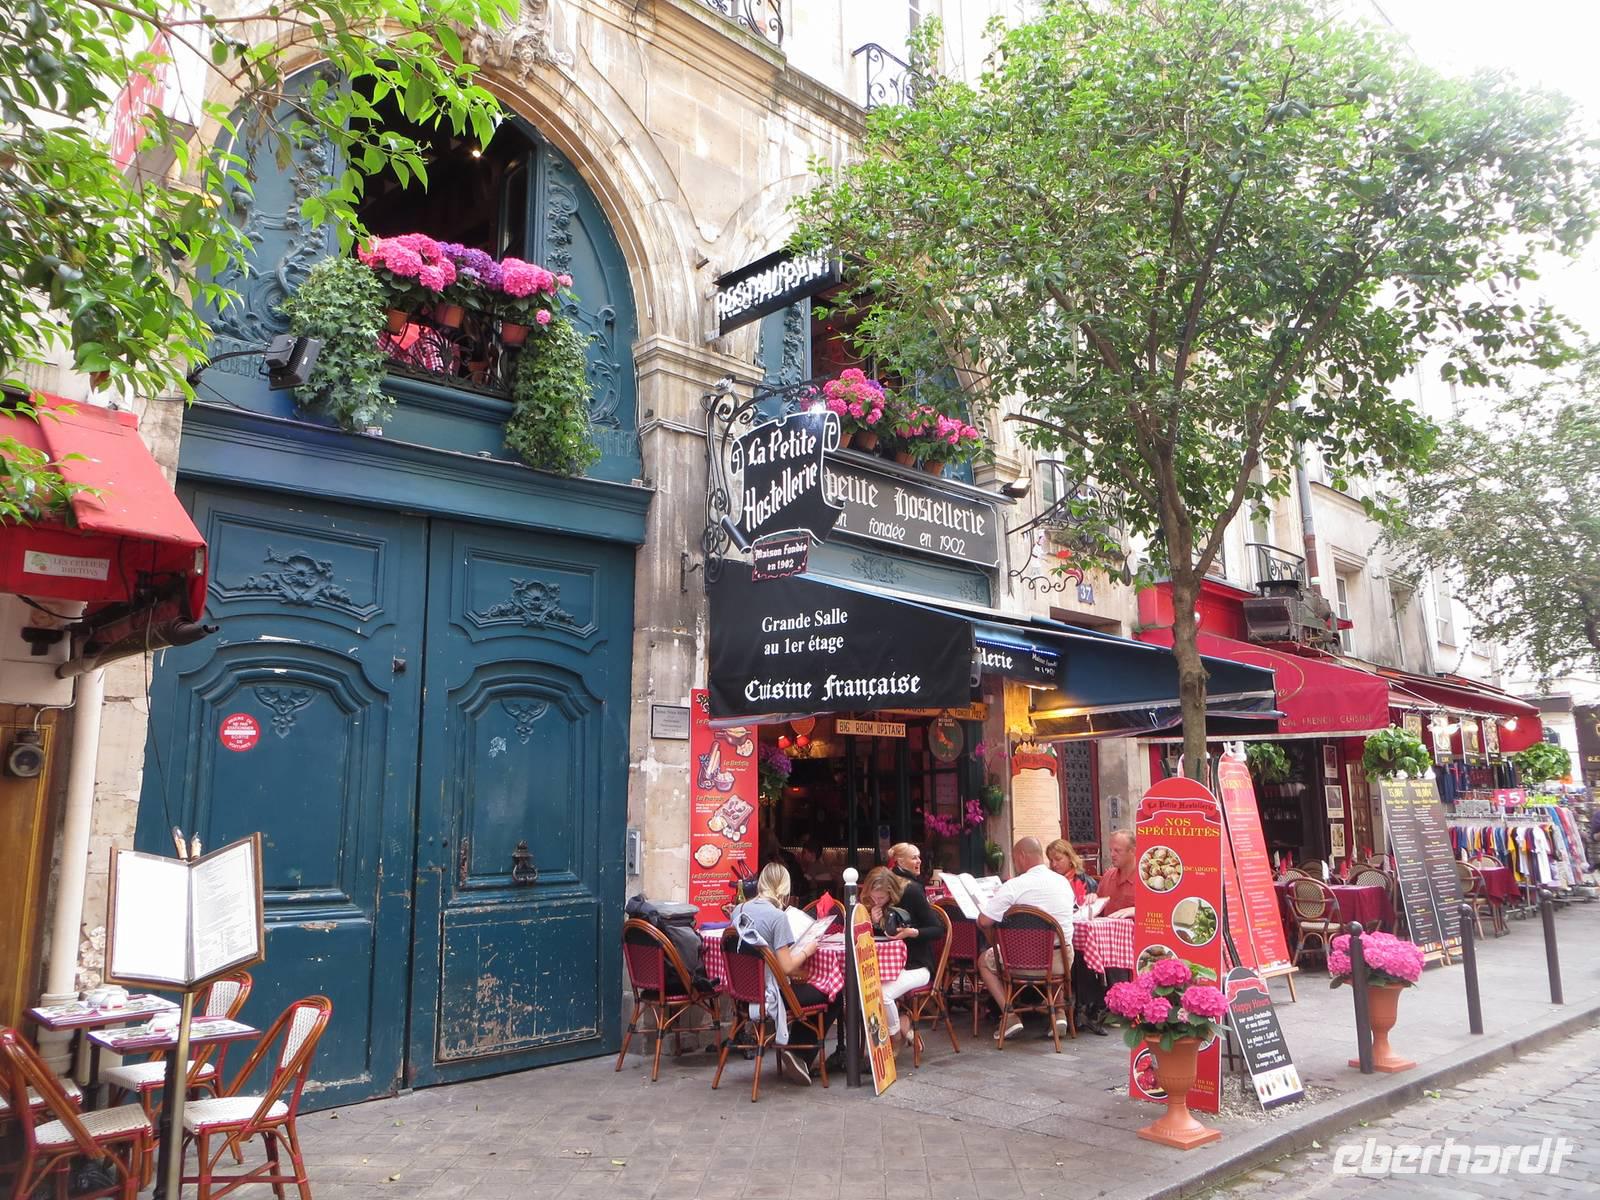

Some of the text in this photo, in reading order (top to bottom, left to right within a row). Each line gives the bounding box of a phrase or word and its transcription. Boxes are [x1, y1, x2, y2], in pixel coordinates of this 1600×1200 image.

[748, 429, 817, 466] La Petite
[744, 462, 818, 532] Hostellerie
[868, 518, 906, 541] fondée
[919, 533, 932, 547] en
[940, 536, 966, 555] 1902
[755, 547, 782, 560] Maison
[777, 559, 794, 570] 1902
[1080, 585, 1091, 600] 37
[762, 608, 848, 632] Grande Salle
[764, 635, 844, 655] au 1er étage
[745, 672, 921, 701] Cuisine Française
[839, 722, 905, 735] BIG ROOM UPSTAIRS
[1165, 817, 1191, 827] NOS
